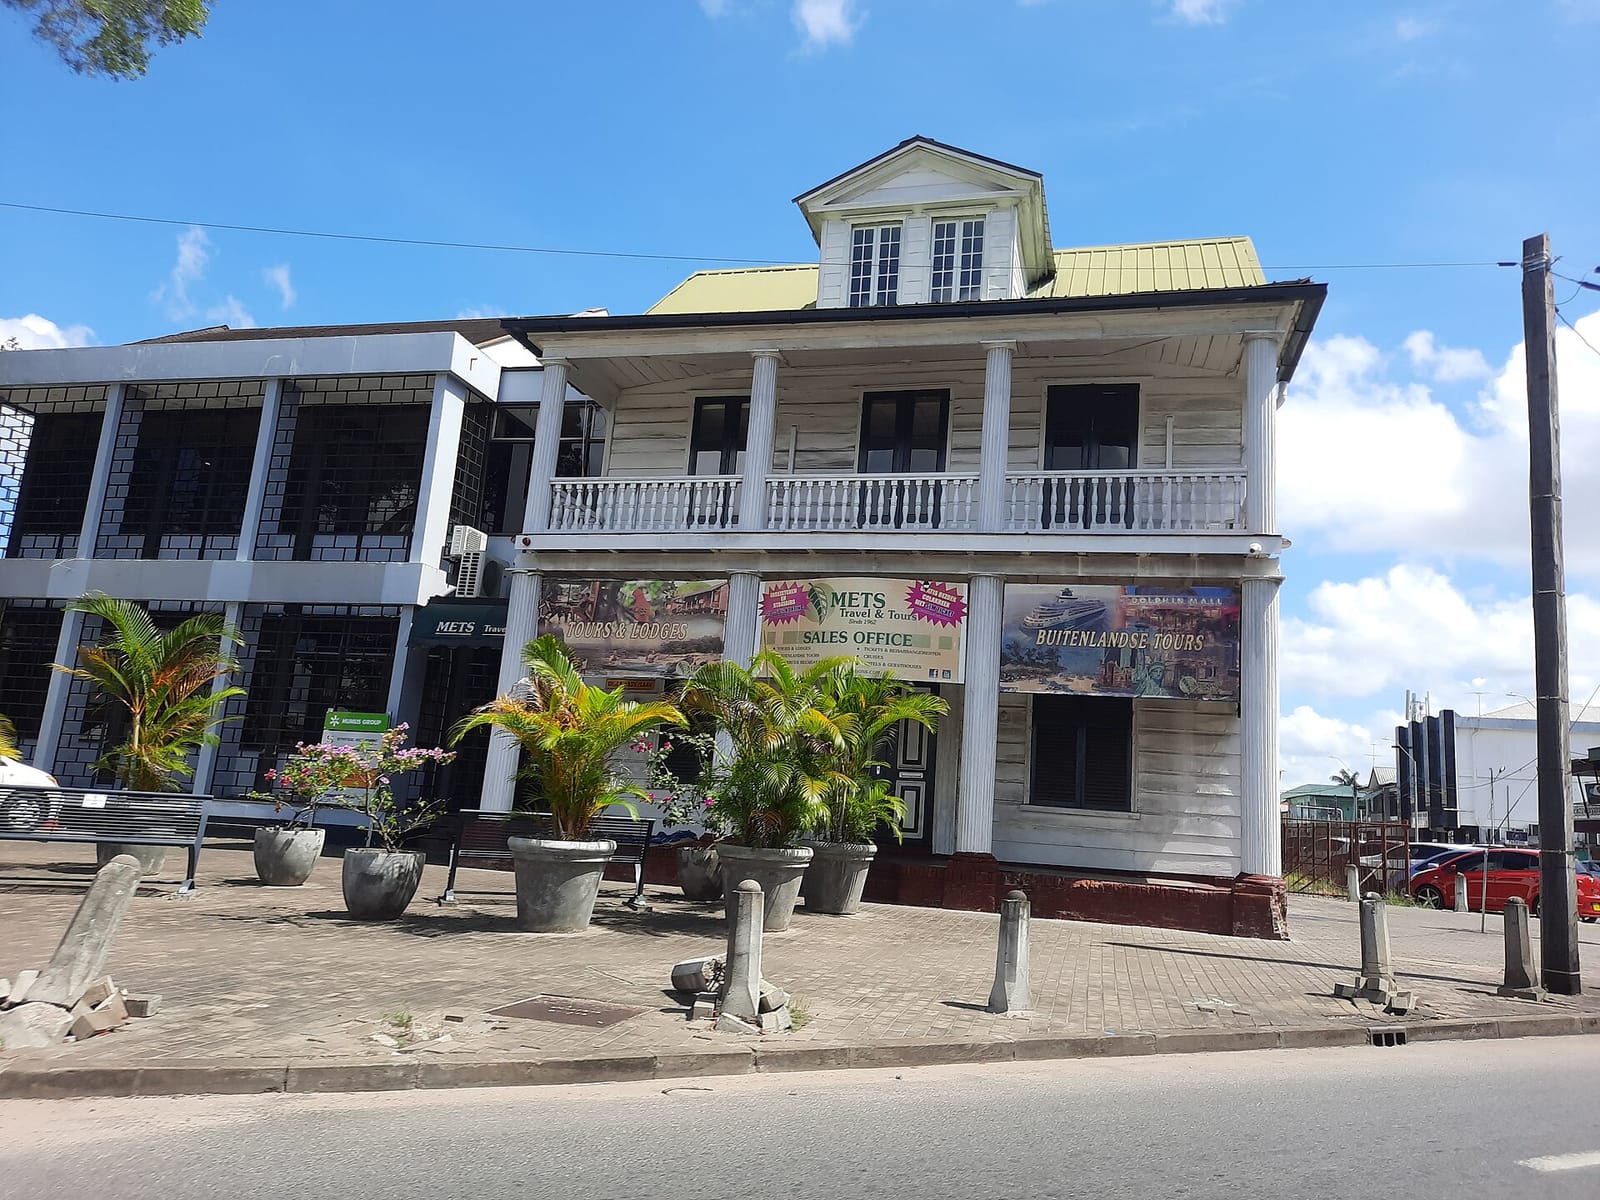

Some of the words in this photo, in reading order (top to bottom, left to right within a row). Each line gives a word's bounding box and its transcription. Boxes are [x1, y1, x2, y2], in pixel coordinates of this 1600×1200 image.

[831, 592, 886, 608] METS
[1131, 597, 1184, 605] DOLPHIN
[840, 608, 872, 619] Travel
[874, 609, 885, 619] &
[888, 610, 918, 622] Tours
[436, 621, 476, 633] METS
[484, 624, 506, 633] Trave
[567, 621, 613, 638] TOURS
[615, 624, 627, 639] &
[630, 622, 689, 640] LODGES
[803, 630, 848, 645] SALES
[854, 631, 913, 647] OFFICE
[1035, 629, 1148, 650] BUITENLANDSE
[1152, 632, 1205, 651] TOURS
